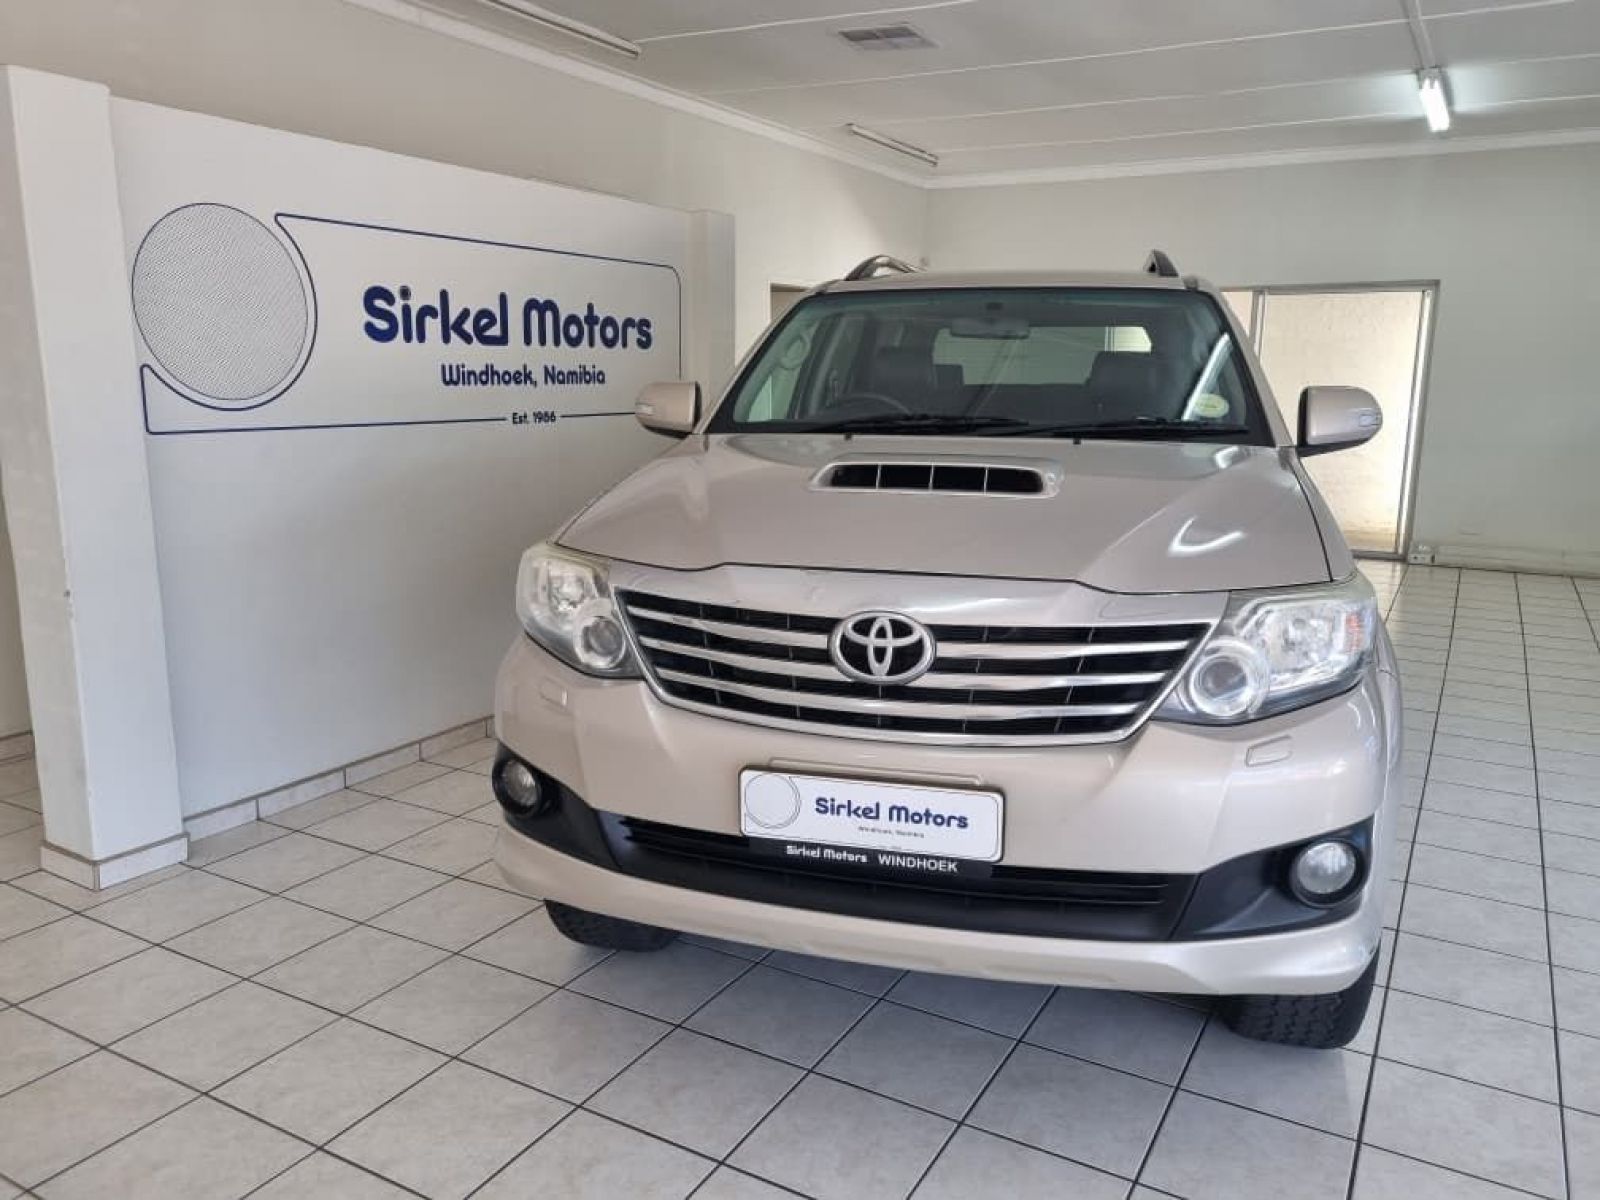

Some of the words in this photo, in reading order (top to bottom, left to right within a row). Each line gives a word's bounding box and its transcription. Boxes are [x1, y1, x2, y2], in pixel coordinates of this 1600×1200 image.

[363, 285, 508, 346] Sirkel
[523, 298, 652, 349] Motors
[441, 364, 537, 387] Windhoek,
[544, 365, 605, 385] Namibia
[815, 797, 880, 819] Sirkel
[889, 805, 969, 828] Motors
[786, 845, 820, 858] Sirkel
[823, 848, 868, 863] Motors
[878, 853, 958, 873] WINDHOEK
